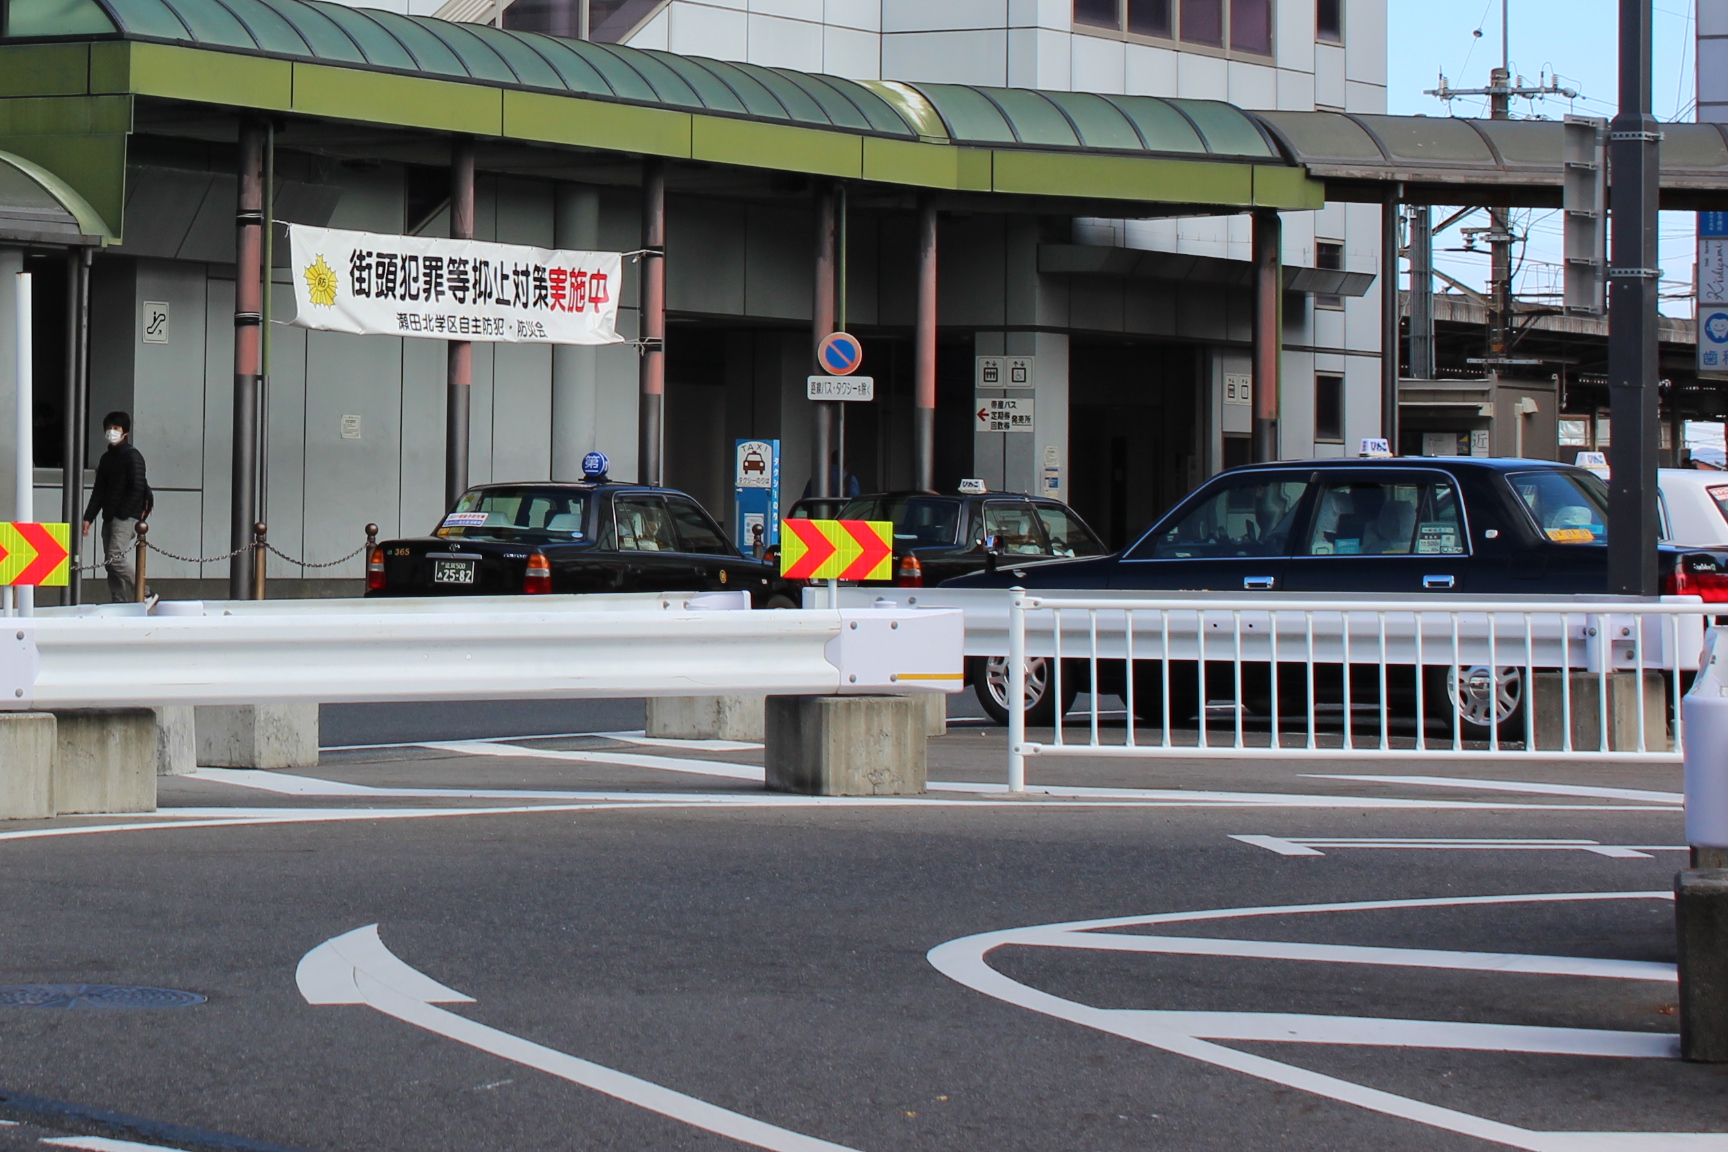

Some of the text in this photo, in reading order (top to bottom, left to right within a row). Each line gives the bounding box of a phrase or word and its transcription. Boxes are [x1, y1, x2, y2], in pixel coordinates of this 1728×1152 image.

[349, 248, 610, 314] 街頭犯罪等抑止対策実施中
[990, 400, 1017, 410] 帝産バス
[990, 411, 1010, 420] 定期券
[990, 421, 1010, 431] 回数券
[741, 443, 768, 453] TAXI
[738, 477, 770, 485] タクシーのりば
[395, 548, 410, 556] 365
